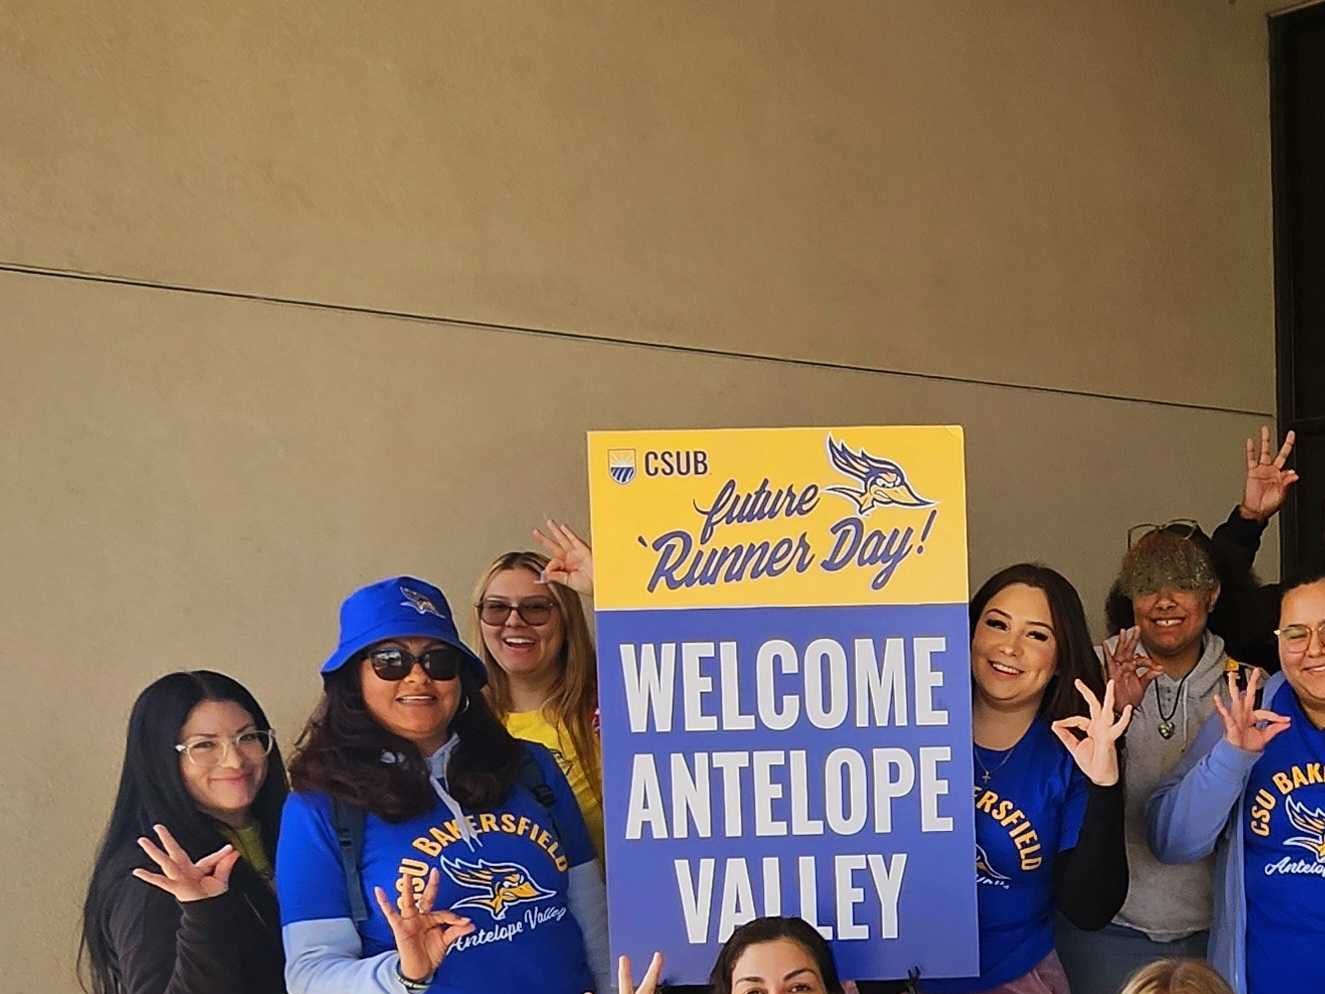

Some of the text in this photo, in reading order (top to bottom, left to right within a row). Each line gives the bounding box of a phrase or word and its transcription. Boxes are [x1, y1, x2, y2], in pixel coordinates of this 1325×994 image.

[644, 451, 709, 476] CSUB
[693, 478, 820, 544] future
[820, 509, 938, 591] Day!
[619, 637, 949, 733] WELCOME
[625, 746, 954, 840] ANTELOPE
[1251, 788, 1276, 837] CSU
[524, 906, 567, 929] Valley
[674, 853, 907, 944] VALLEY
